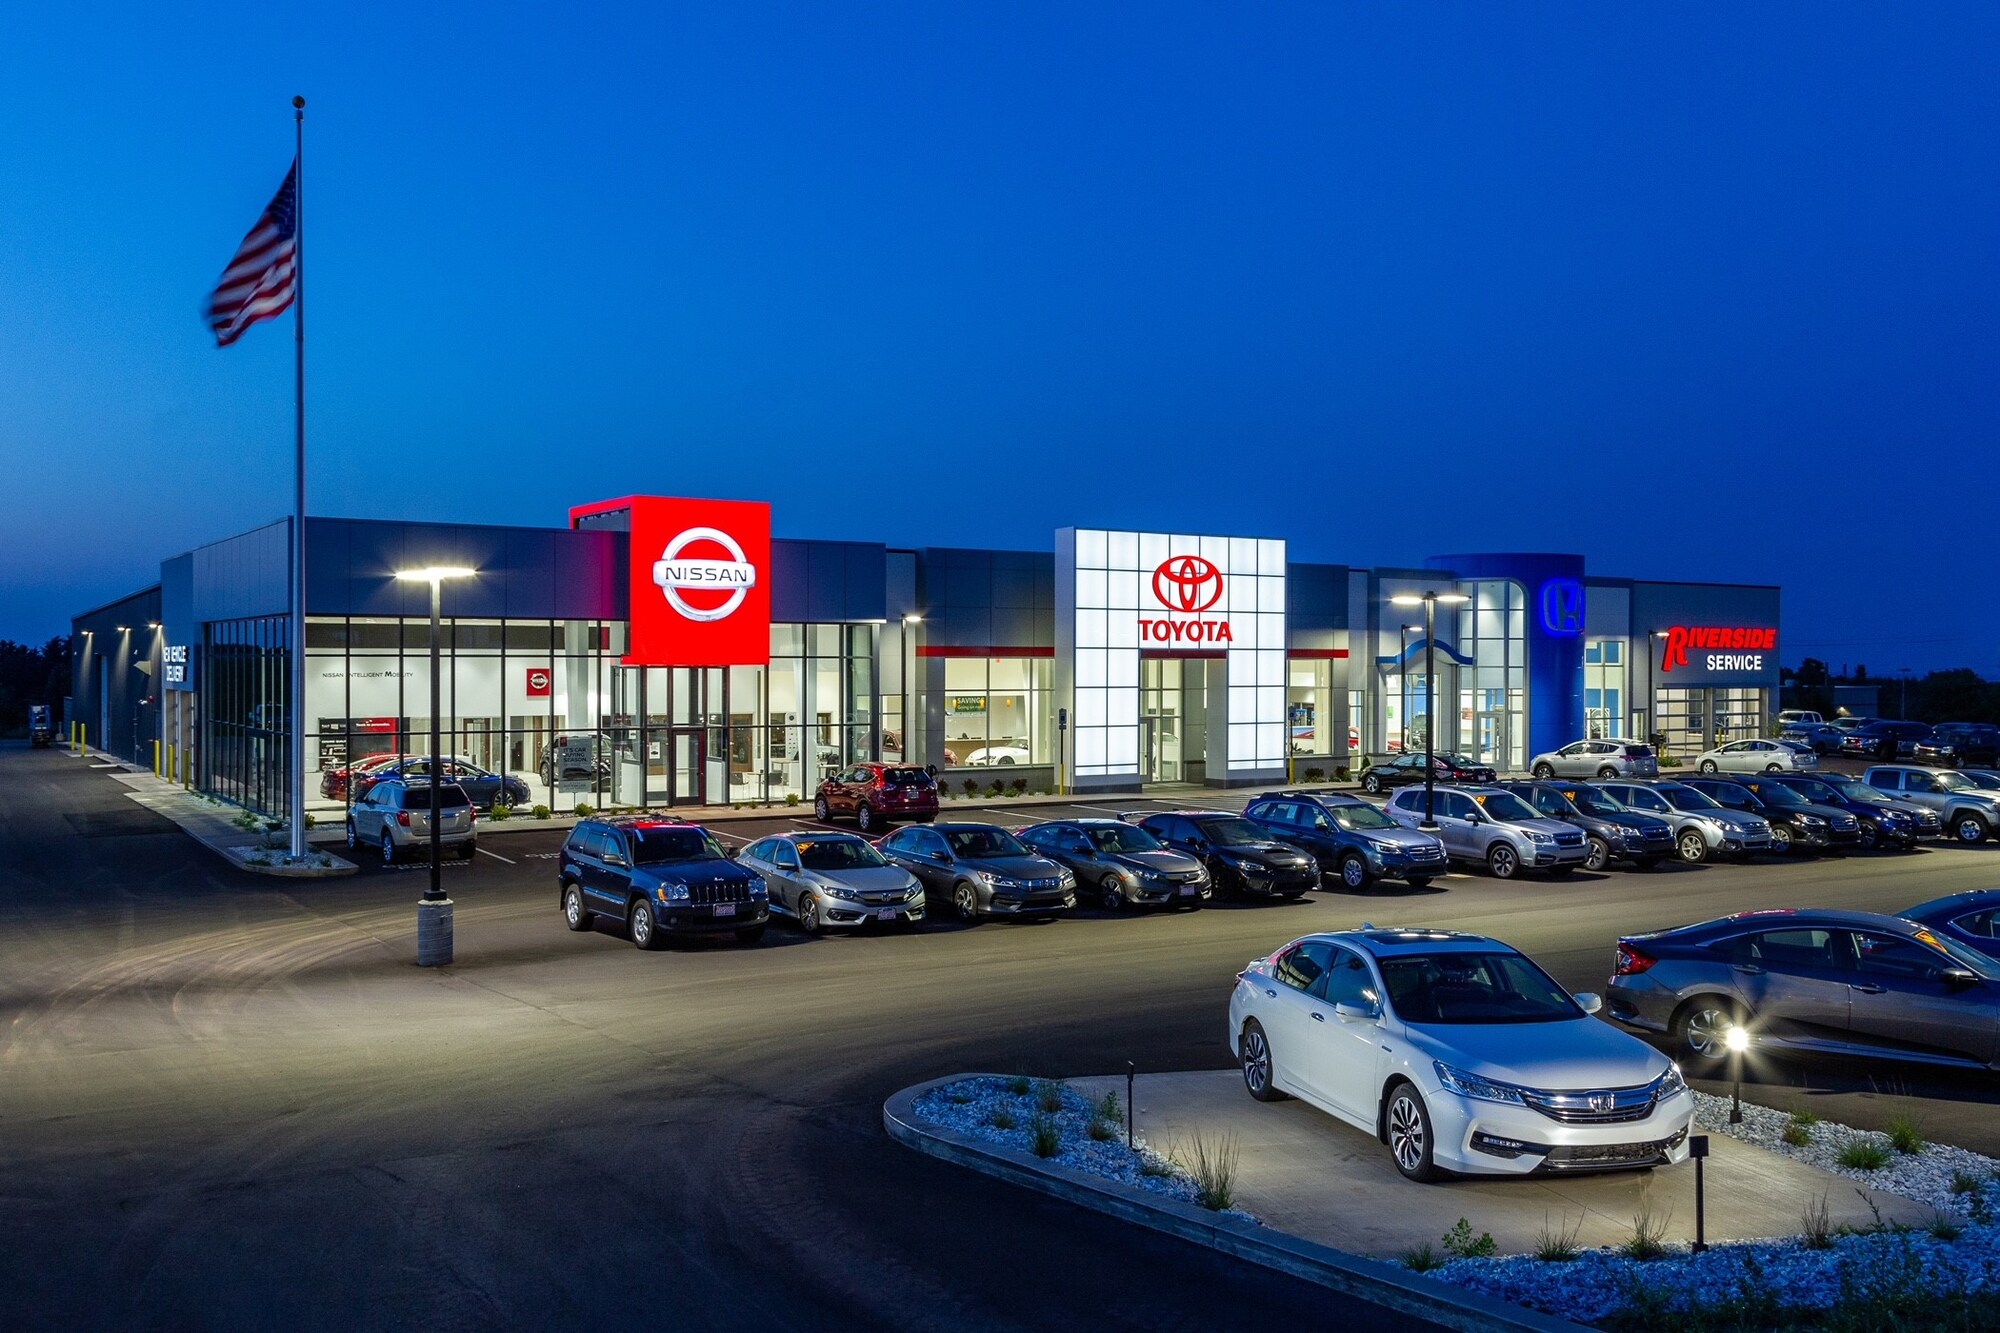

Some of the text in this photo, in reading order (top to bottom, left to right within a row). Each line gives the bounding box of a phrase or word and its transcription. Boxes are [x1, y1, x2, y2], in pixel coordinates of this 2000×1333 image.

[665, 567, 747, 582] NISSAN
[1137, 619, 1233, 642] TOYOTA
[1661, 625, 1777, 672] RIVERSIDE
[1706, 654, 1762, 671] SERVICE
